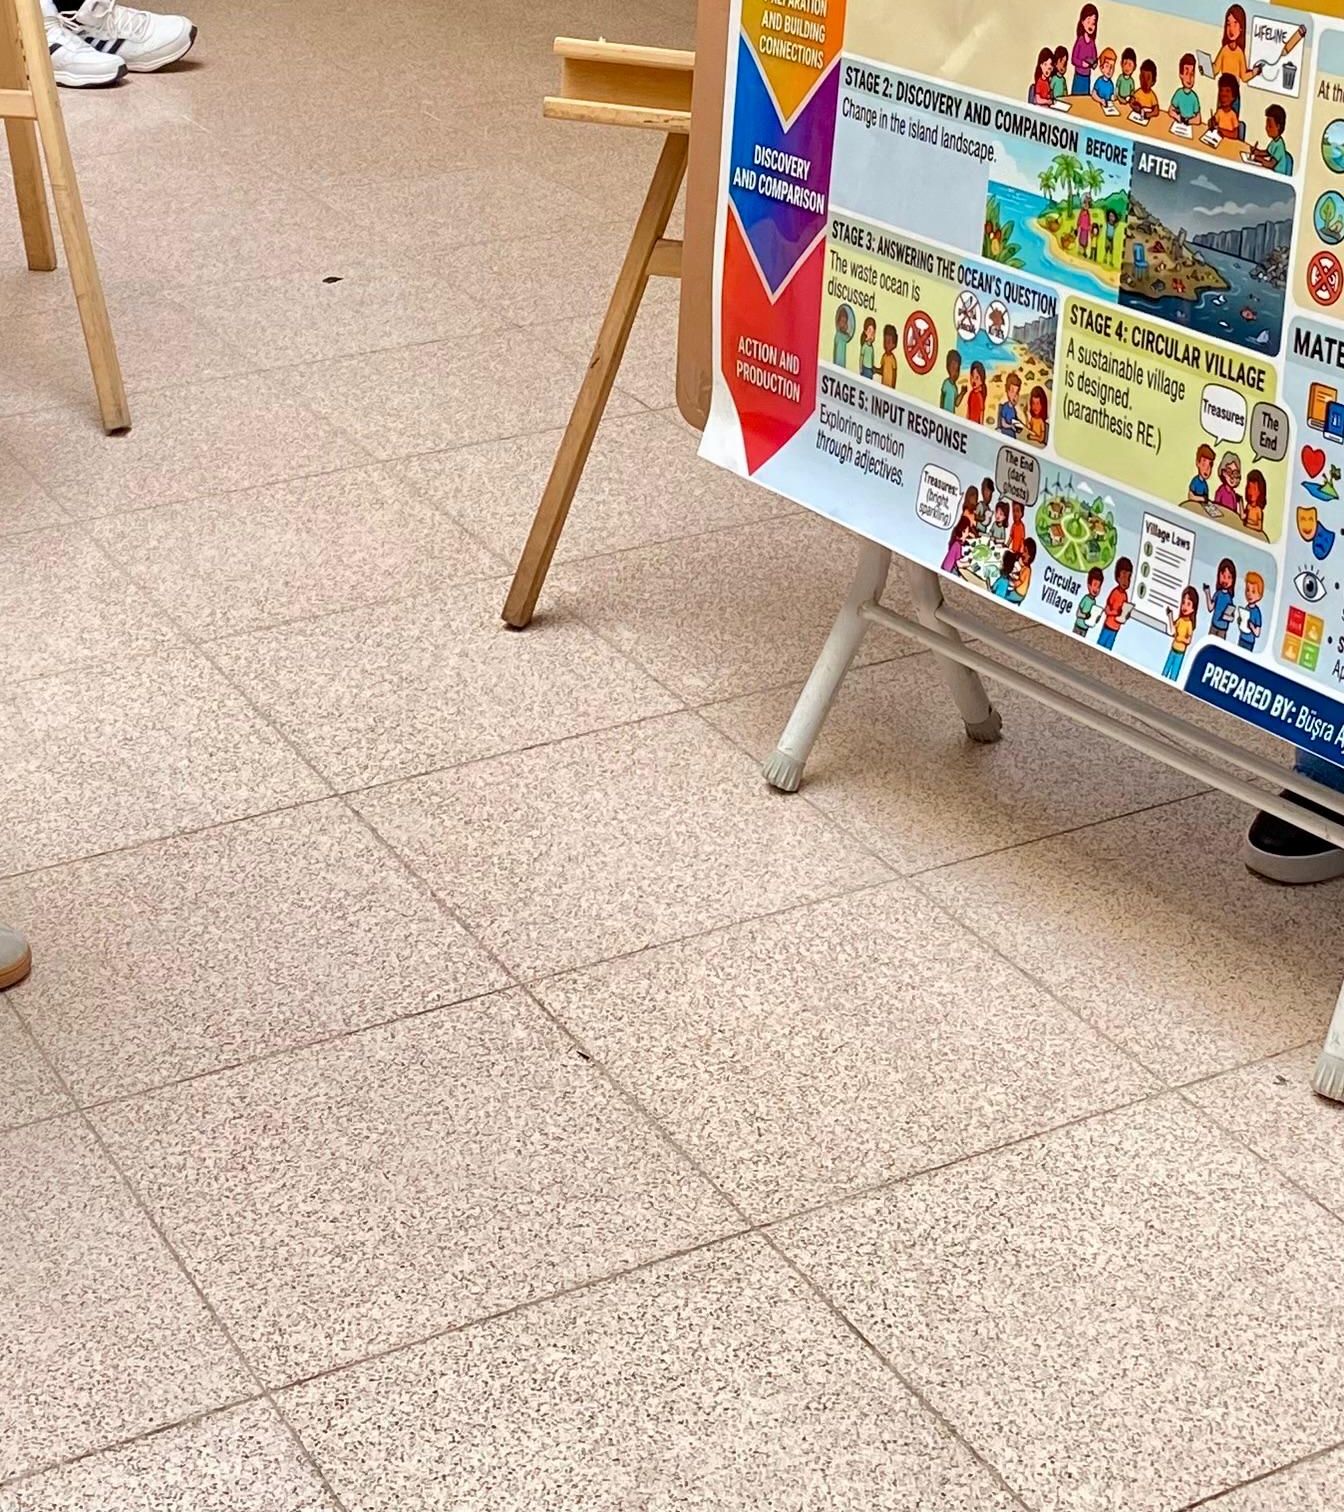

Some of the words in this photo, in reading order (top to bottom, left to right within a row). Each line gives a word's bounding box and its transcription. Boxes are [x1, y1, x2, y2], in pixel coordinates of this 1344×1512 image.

[761, 9, 782, 30] AND
[783, 14, 825, 43] BUILDING
[759, 34, 823, 69] CONNECTIONS
[844, 65, 880, 94] STAGE
[881, 76, 893, 98] 2:
[895, 80, 962, 118] DISCOVERY
[963, 100, 991, 126] AND
[994, 108, 1078, 152] COMPARISON
[1316, 79, 1330, 100] At
[842, 96, 877, 128] Change
[878, 108, 887, 128] in
[890, 112, 905, 135] the
[908, 119, 938, 145] island
[940, 126, 996, 163] landscape.
[753, 144, 810, 180] DISCOVERY
[1085, 136, 1128, 166] BEFORE
[1137, 152, 1177, 179] AFTER
[732, 166, 756, 190] AND
[757, 173, 824, 214] COMPARISON
[829, 248, 847, 274] The
[850, 261, 877, 286] waste
[879, 272, 909, 297] ocean
[911, 280, 920, 302] is
[831, 219, 864, 248] STAGE
[865, 231, 875, 252] 3:
[876, 235, 933, 273] ANSWERING
[936, 255, 955, 281] THE
[956, 264, 1001, 297] OCEAN'S
[1003, 280, 1057, 319] QUESTION
[827, 275, 876, 312] discussed.
[737, 335, 777, 365] ACTION
[778, 350, 799, 374] AND
[1069, 303, 1112, 337] STAGE
[1114, 320, 1127, 343] 4:
[1131, 325, 1200, 369] CIRCULAR
[1204, 350, 1265, 392] VILLAGE
[736, 359, 800, 402] PRODUCTION
[1064, 364, 1074, 388] is
[1077, 370, 1132, 410] designed.
[1066, 337, 1074, 360] A
[1077, 345, 1143, 385] sustainable
[1146, 368, 1185, 401] village
[819, 402, 863, 444] Exploring
[864, 427, 904, 458] emotion
[821, 374, 856, 406] STAGE
[857, 389, 868, 411] 5:
[871, 395, 905, 426] INPUT
[907, 410, 967, 454] RESPONSE
[1062, 392, 1133, 440] (paranthesis
[1136, 420, 1161, 454] RE.)
[1202, 397, 1244, 426] Treasures
[1261, 411, 1279, 431] The
[815, 428, 853, 463] through
[853, 449, 903, 486] adjectives.
[1259, 430, 1277, 451] End
[1145, 520, 1170, 543] Village
[1171, 531, 1190, 550] Laws
[1041, 584, 1072, 613] Village
[1043, 565, 1081, 595] Circular
[1201, 662, 1271, 710] PREPARED
[1269, 693, 1296, 723] BY:
[1295, 705, 1334, 741] Büşra
